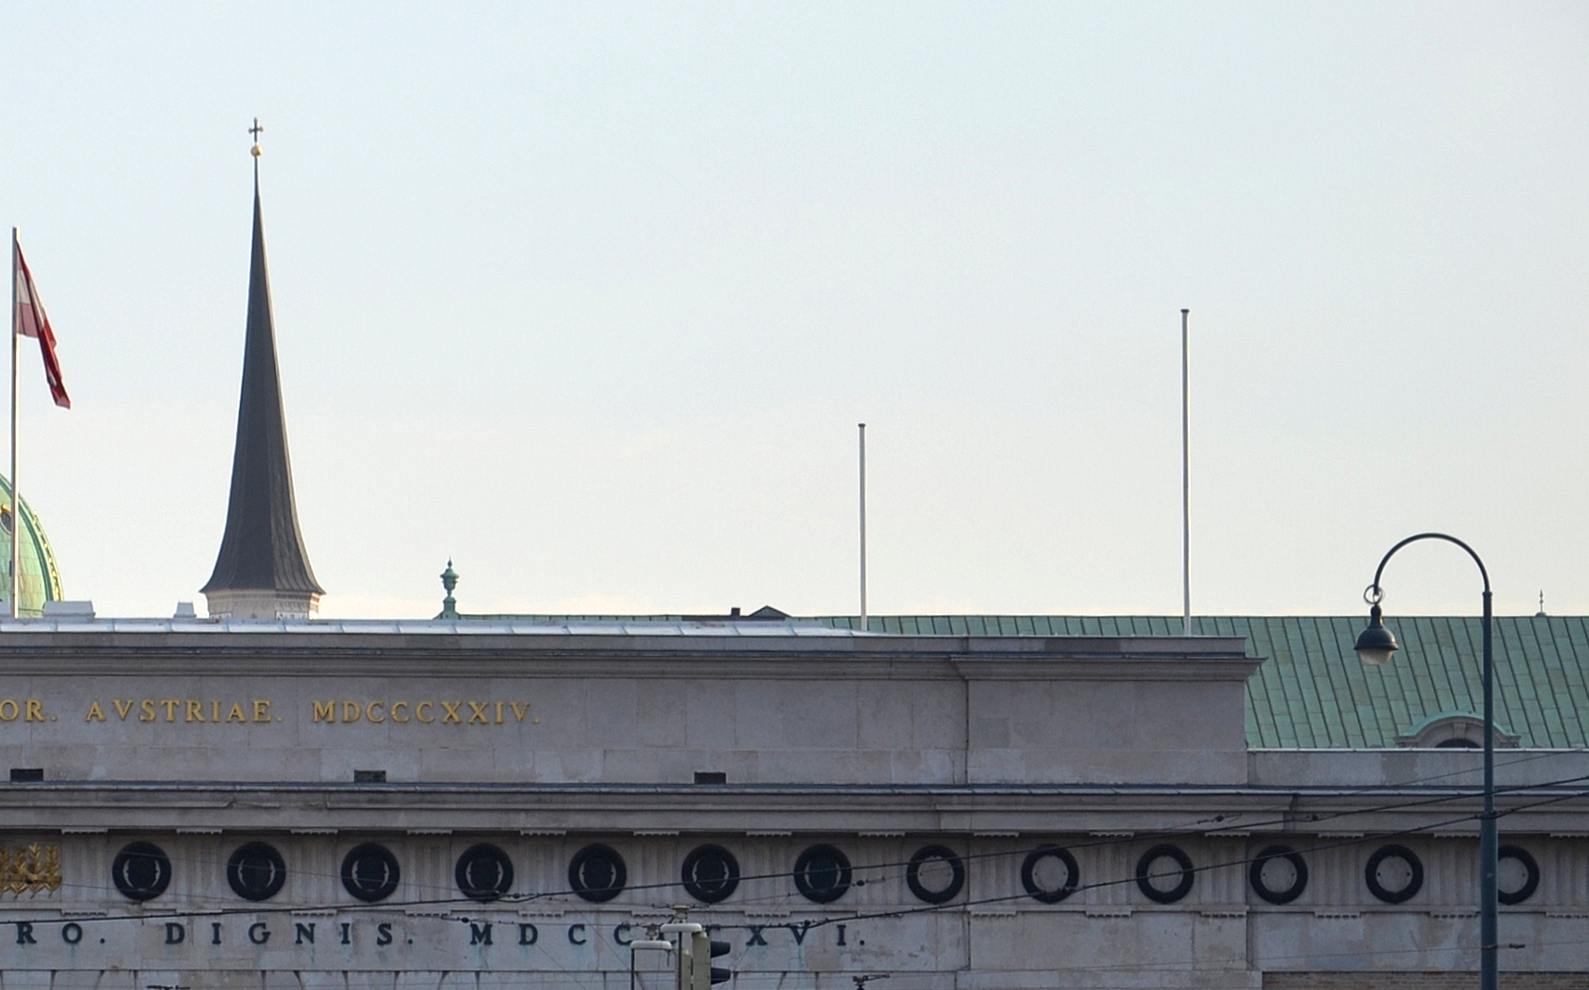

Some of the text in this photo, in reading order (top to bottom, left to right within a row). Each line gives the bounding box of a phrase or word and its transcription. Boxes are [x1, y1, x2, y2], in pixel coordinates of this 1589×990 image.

[86, 700, 283, 722] AVSTRIAE.
[312, 701, 541, 724] MDCCCXXIV.
[164, 923, 413, 946] DIGNIS.
[469, 922, 865, 946] MDCCXVI.
